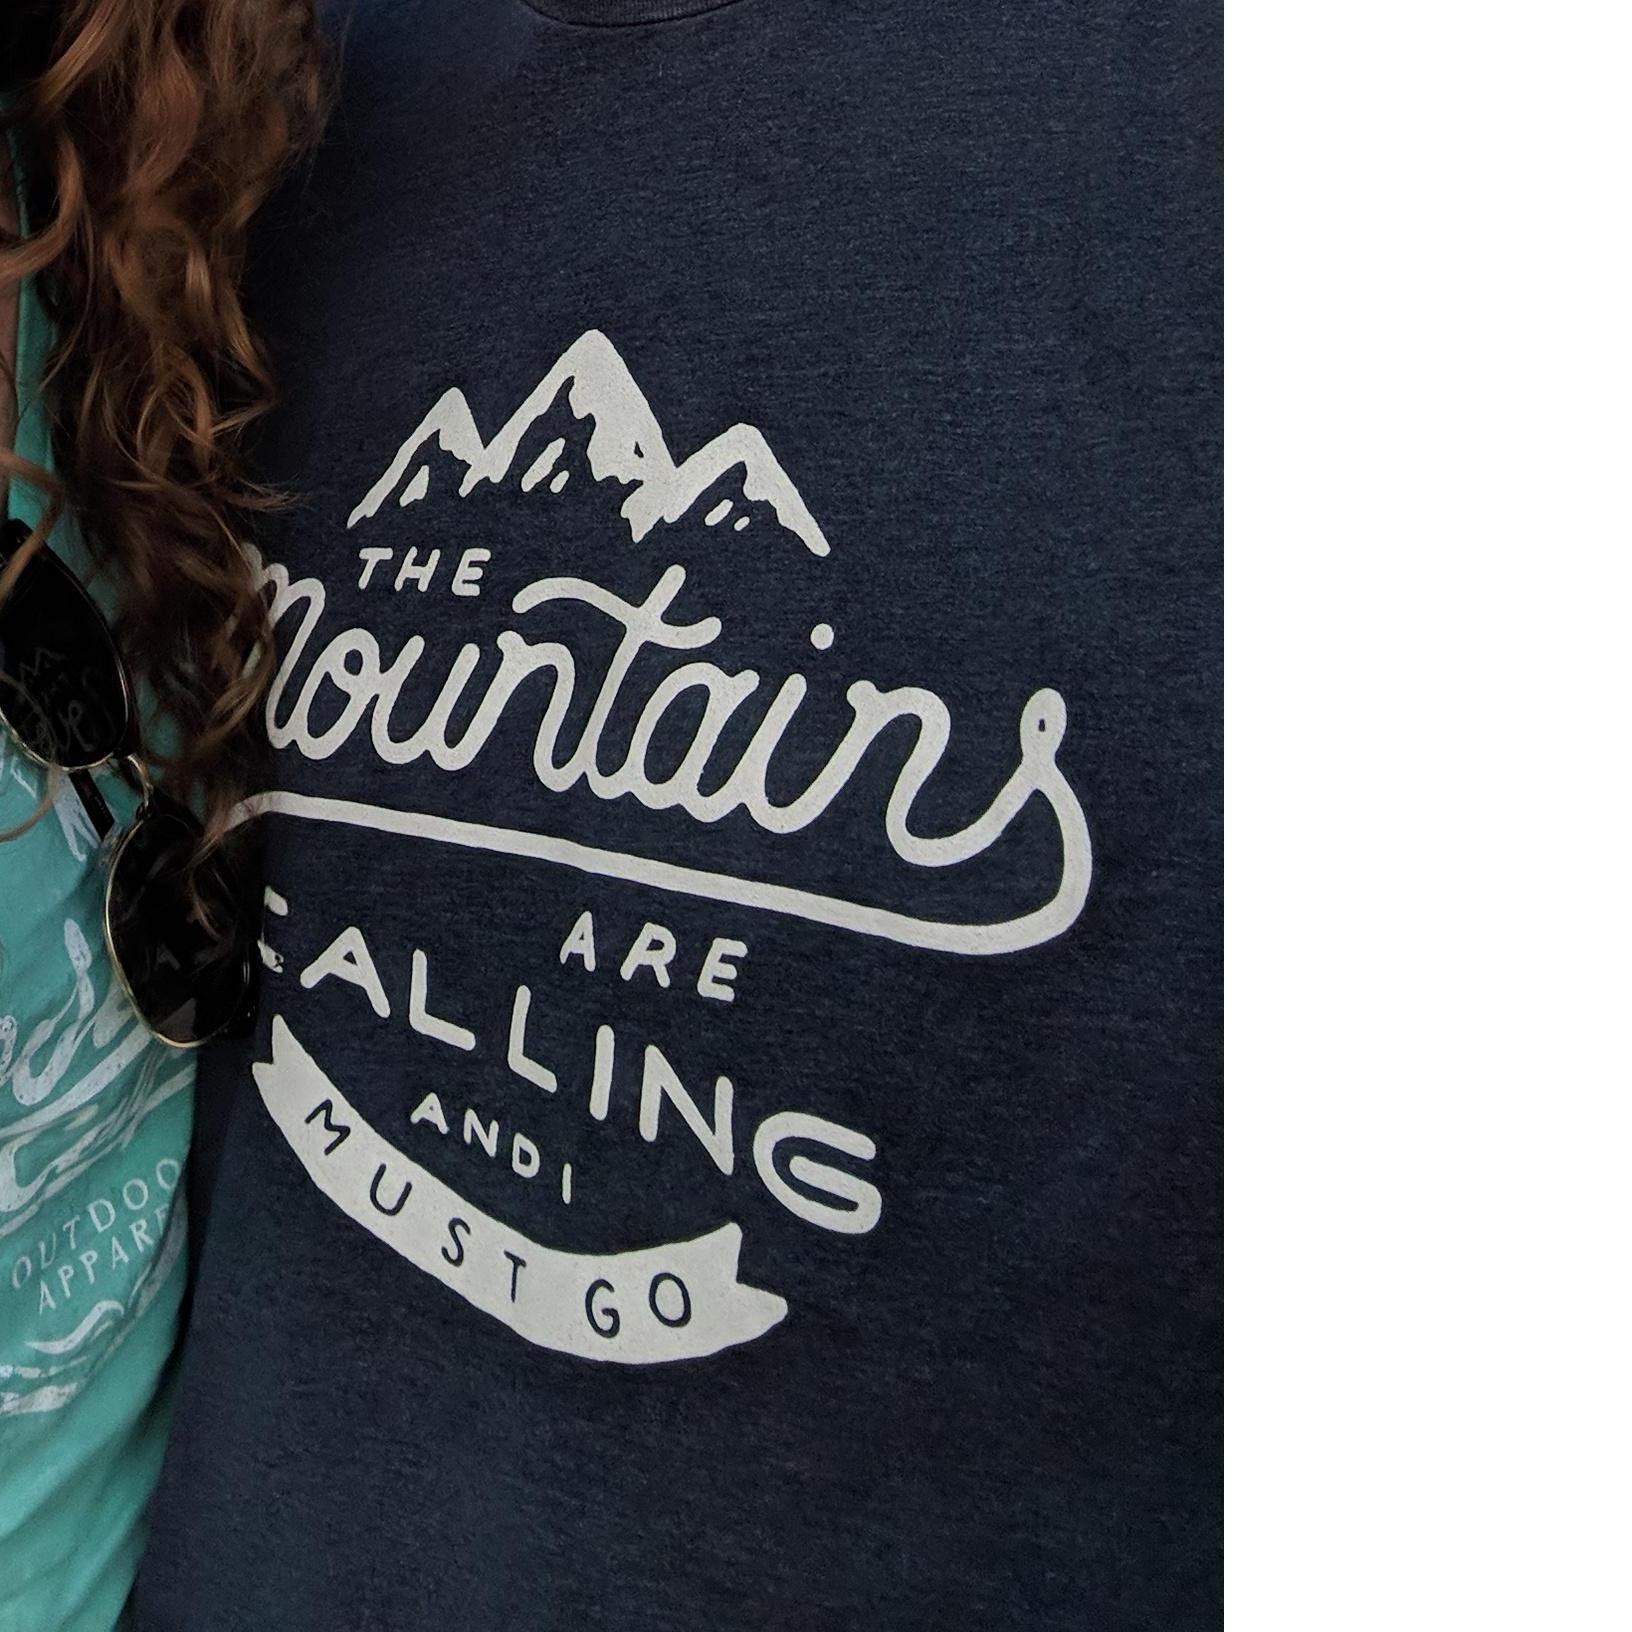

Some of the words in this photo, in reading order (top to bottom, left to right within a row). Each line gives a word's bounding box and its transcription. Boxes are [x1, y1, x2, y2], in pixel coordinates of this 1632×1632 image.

[360, 547, 491, 597] THE
[560, 911, 748, 1001] ARE
[257, 885, 883, 1235] ALLING
[306, 1099, 526, 1303] MUST
[585, 1272, 692, 1339] GO
